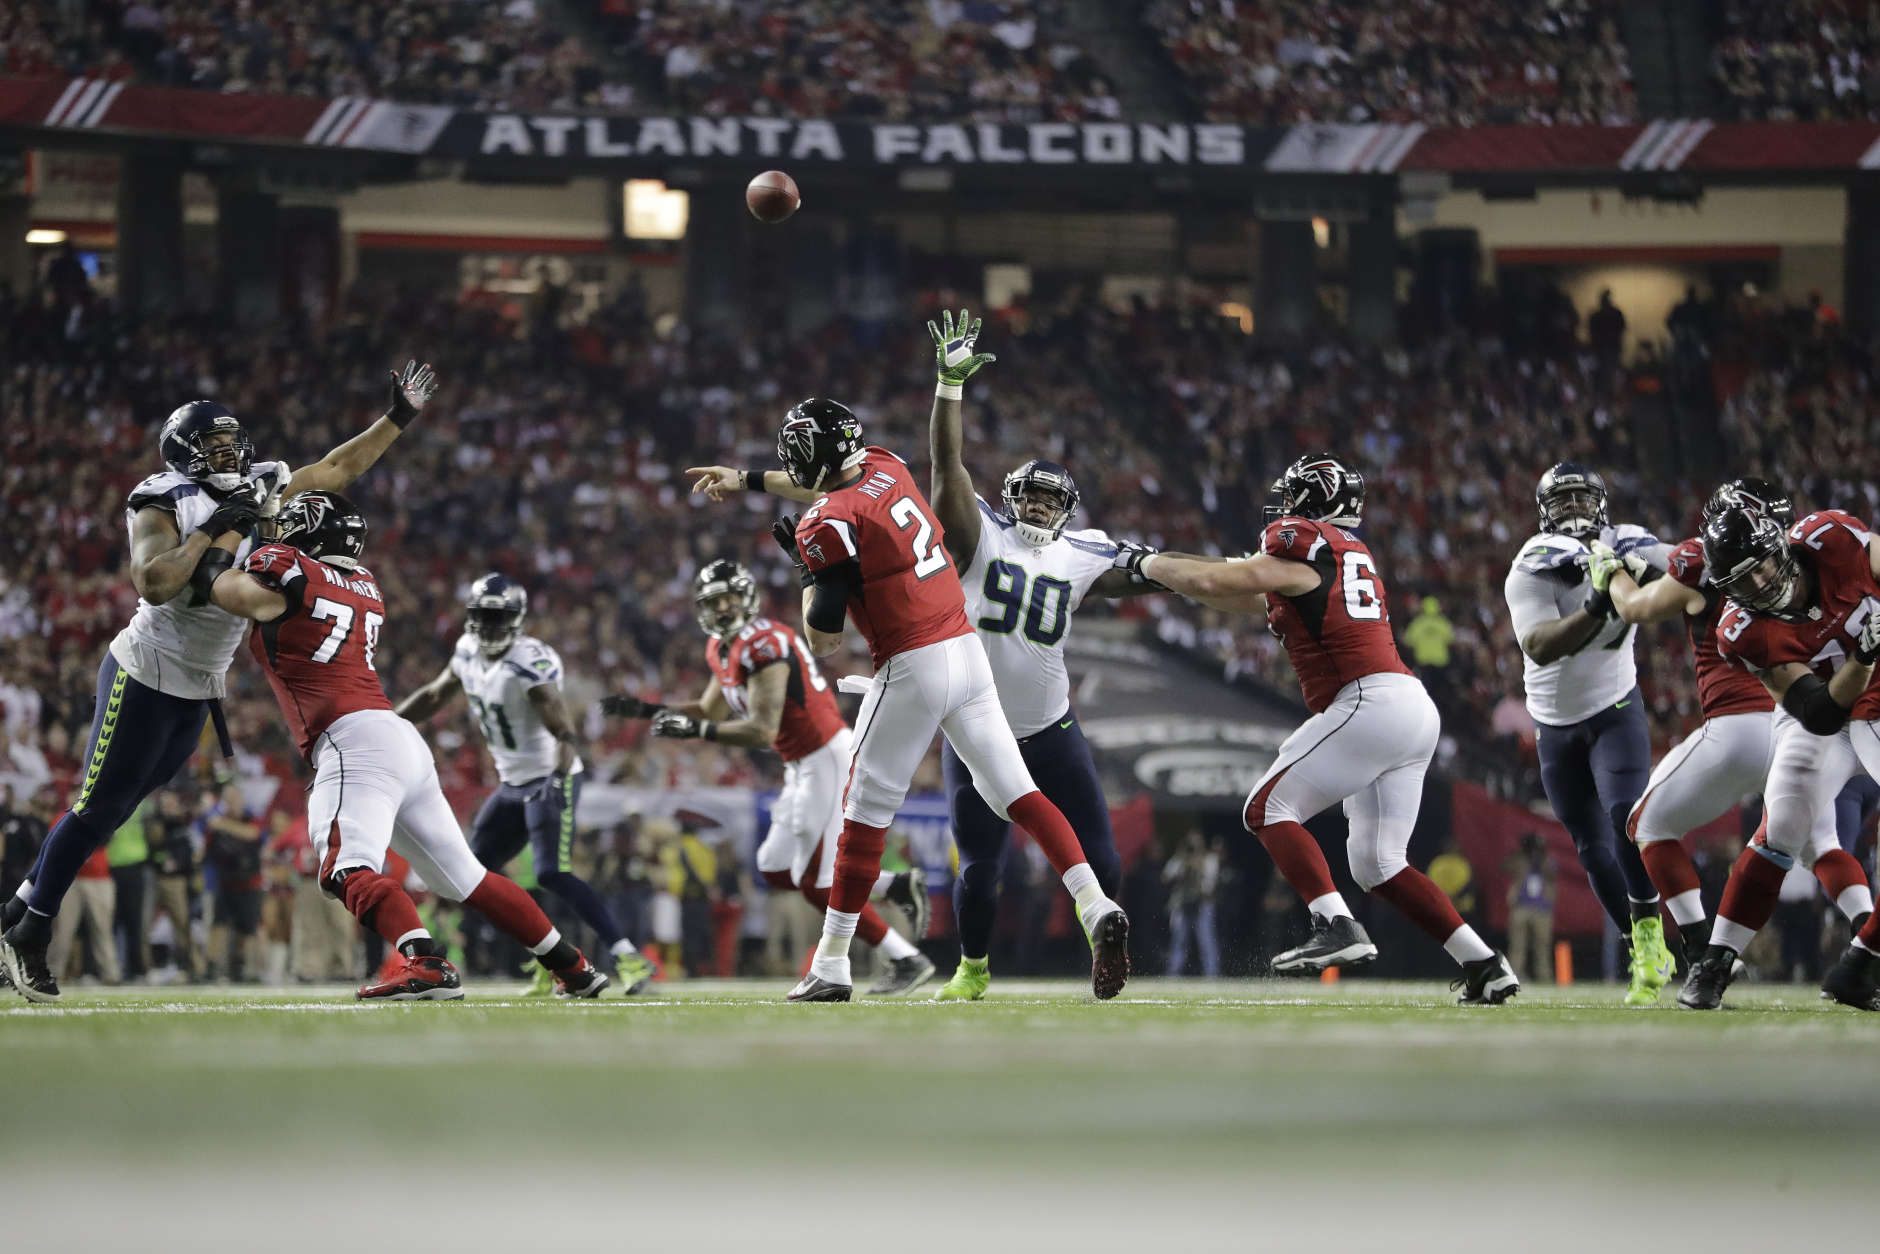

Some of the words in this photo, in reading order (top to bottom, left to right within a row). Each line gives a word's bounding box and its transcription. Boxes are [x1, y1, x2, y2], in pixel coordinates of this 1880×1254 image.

[480, 115, 845, 160] ATLANTA
[872, 121, 1245, 164] FALCONS
[849, 440, 857, 453] 2
[857, 471, 897, 499] RYAN
[805, 497, 829, 520] 2
[889, 495, 950, 582] 2
[977, 557, 1073, 647] 90
